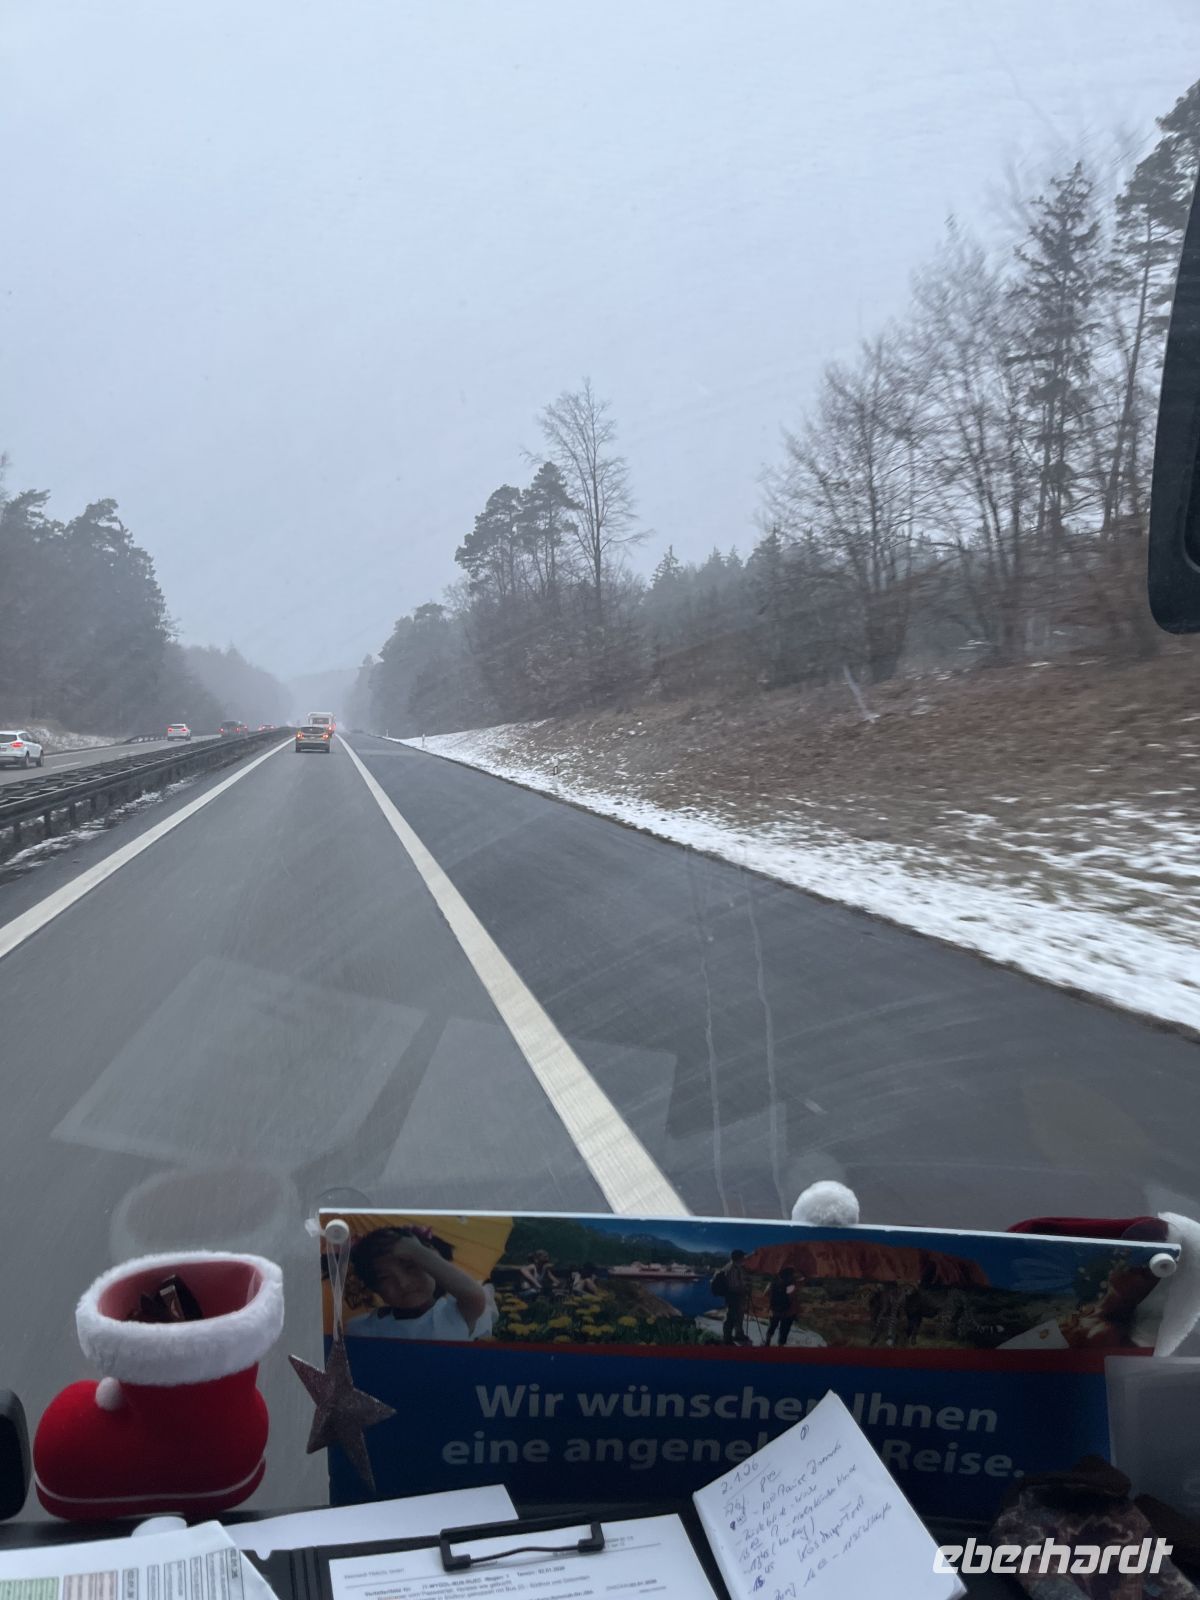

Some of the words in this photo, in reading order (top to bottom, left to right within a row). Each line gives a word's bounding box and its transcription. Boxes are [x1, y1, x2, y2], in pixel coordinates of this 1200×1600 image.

[475, 1383, 564, 1418] Wir
[852, 1391, 998, 1433] Ihnen
[442, 1430, 551, 1465] eine
[563, 1431, 768, 1470] angene
[880, 1438, 1025, 1478] Reise.
